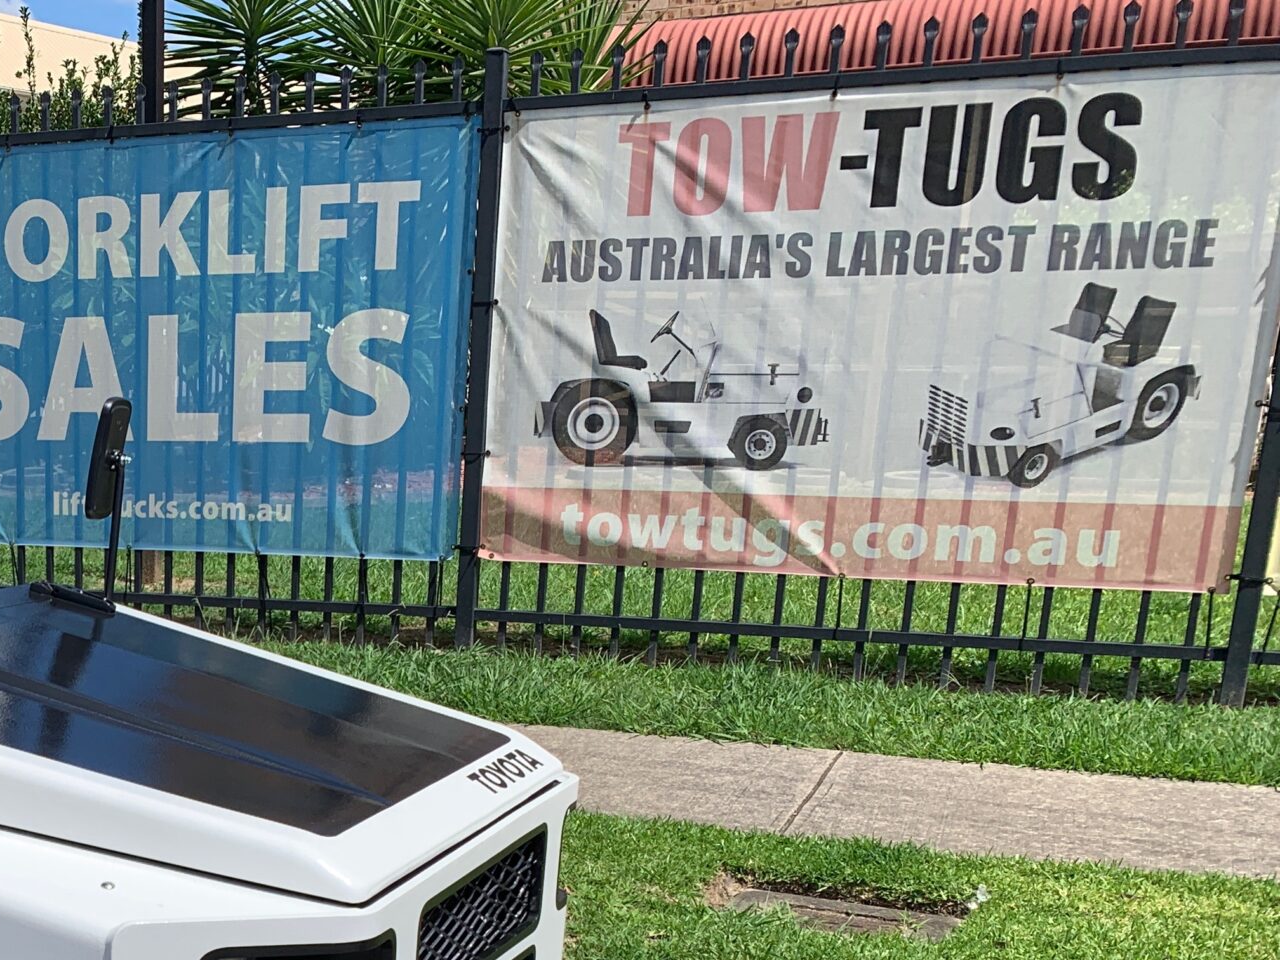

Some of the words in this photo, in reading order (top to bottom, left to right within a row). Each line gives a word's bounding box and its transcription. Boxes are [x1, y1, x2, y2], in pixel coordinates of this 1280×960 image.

[619, 91, 1143, 217] TOW-TUGS
[541, 231, 814, 283] AUSTRALIA'S
[825, 225, 1037, 277] LARGEST
[1046, 218, 1220, 272] RANGE
[52, 490, 293, 522] lifucks.com.au
[560, 502, 1120, 569] towtugs.com.au
[466, 749, 544, 794] TOYOTA
